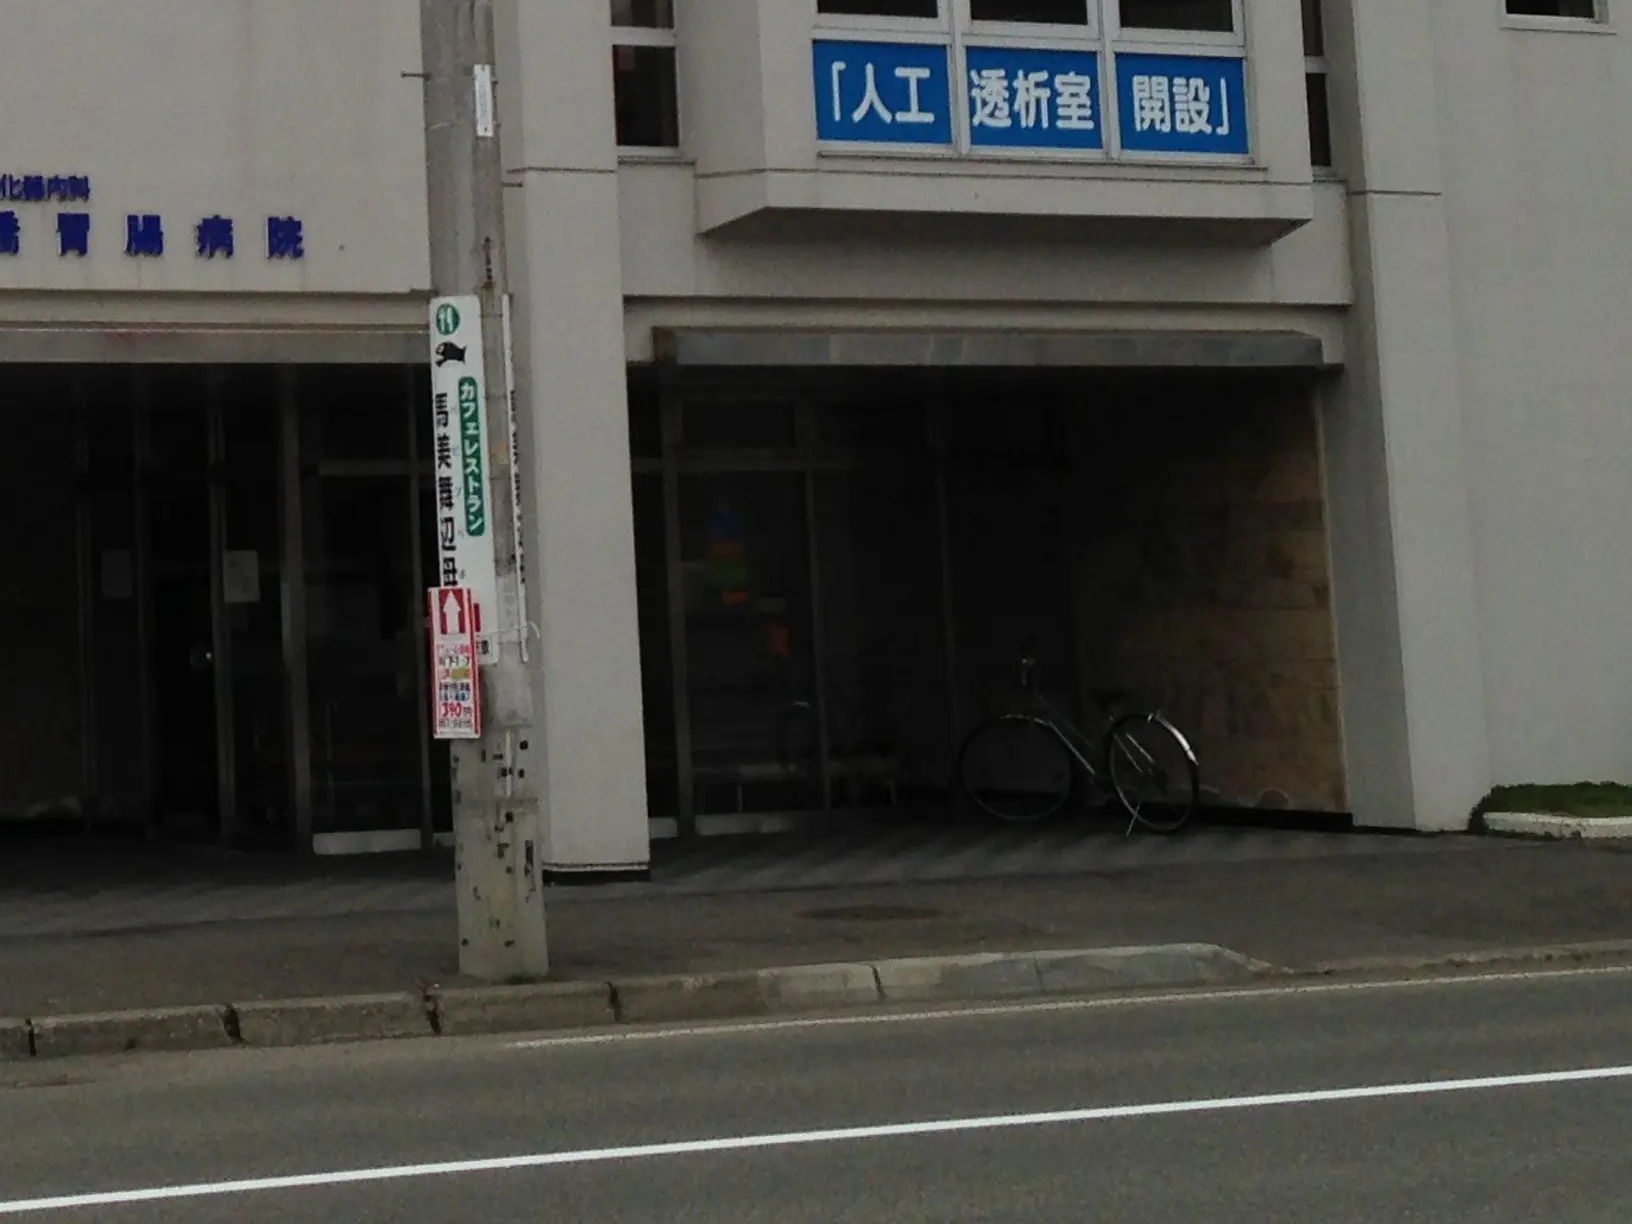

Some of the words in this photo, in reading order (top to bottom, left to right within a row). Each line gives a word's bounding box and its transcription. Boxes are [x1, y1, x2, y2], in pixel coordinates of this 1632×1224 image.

[970, 68, 1095, 130] 透析室
[460, 382, 484, 534] カフェレストラン
